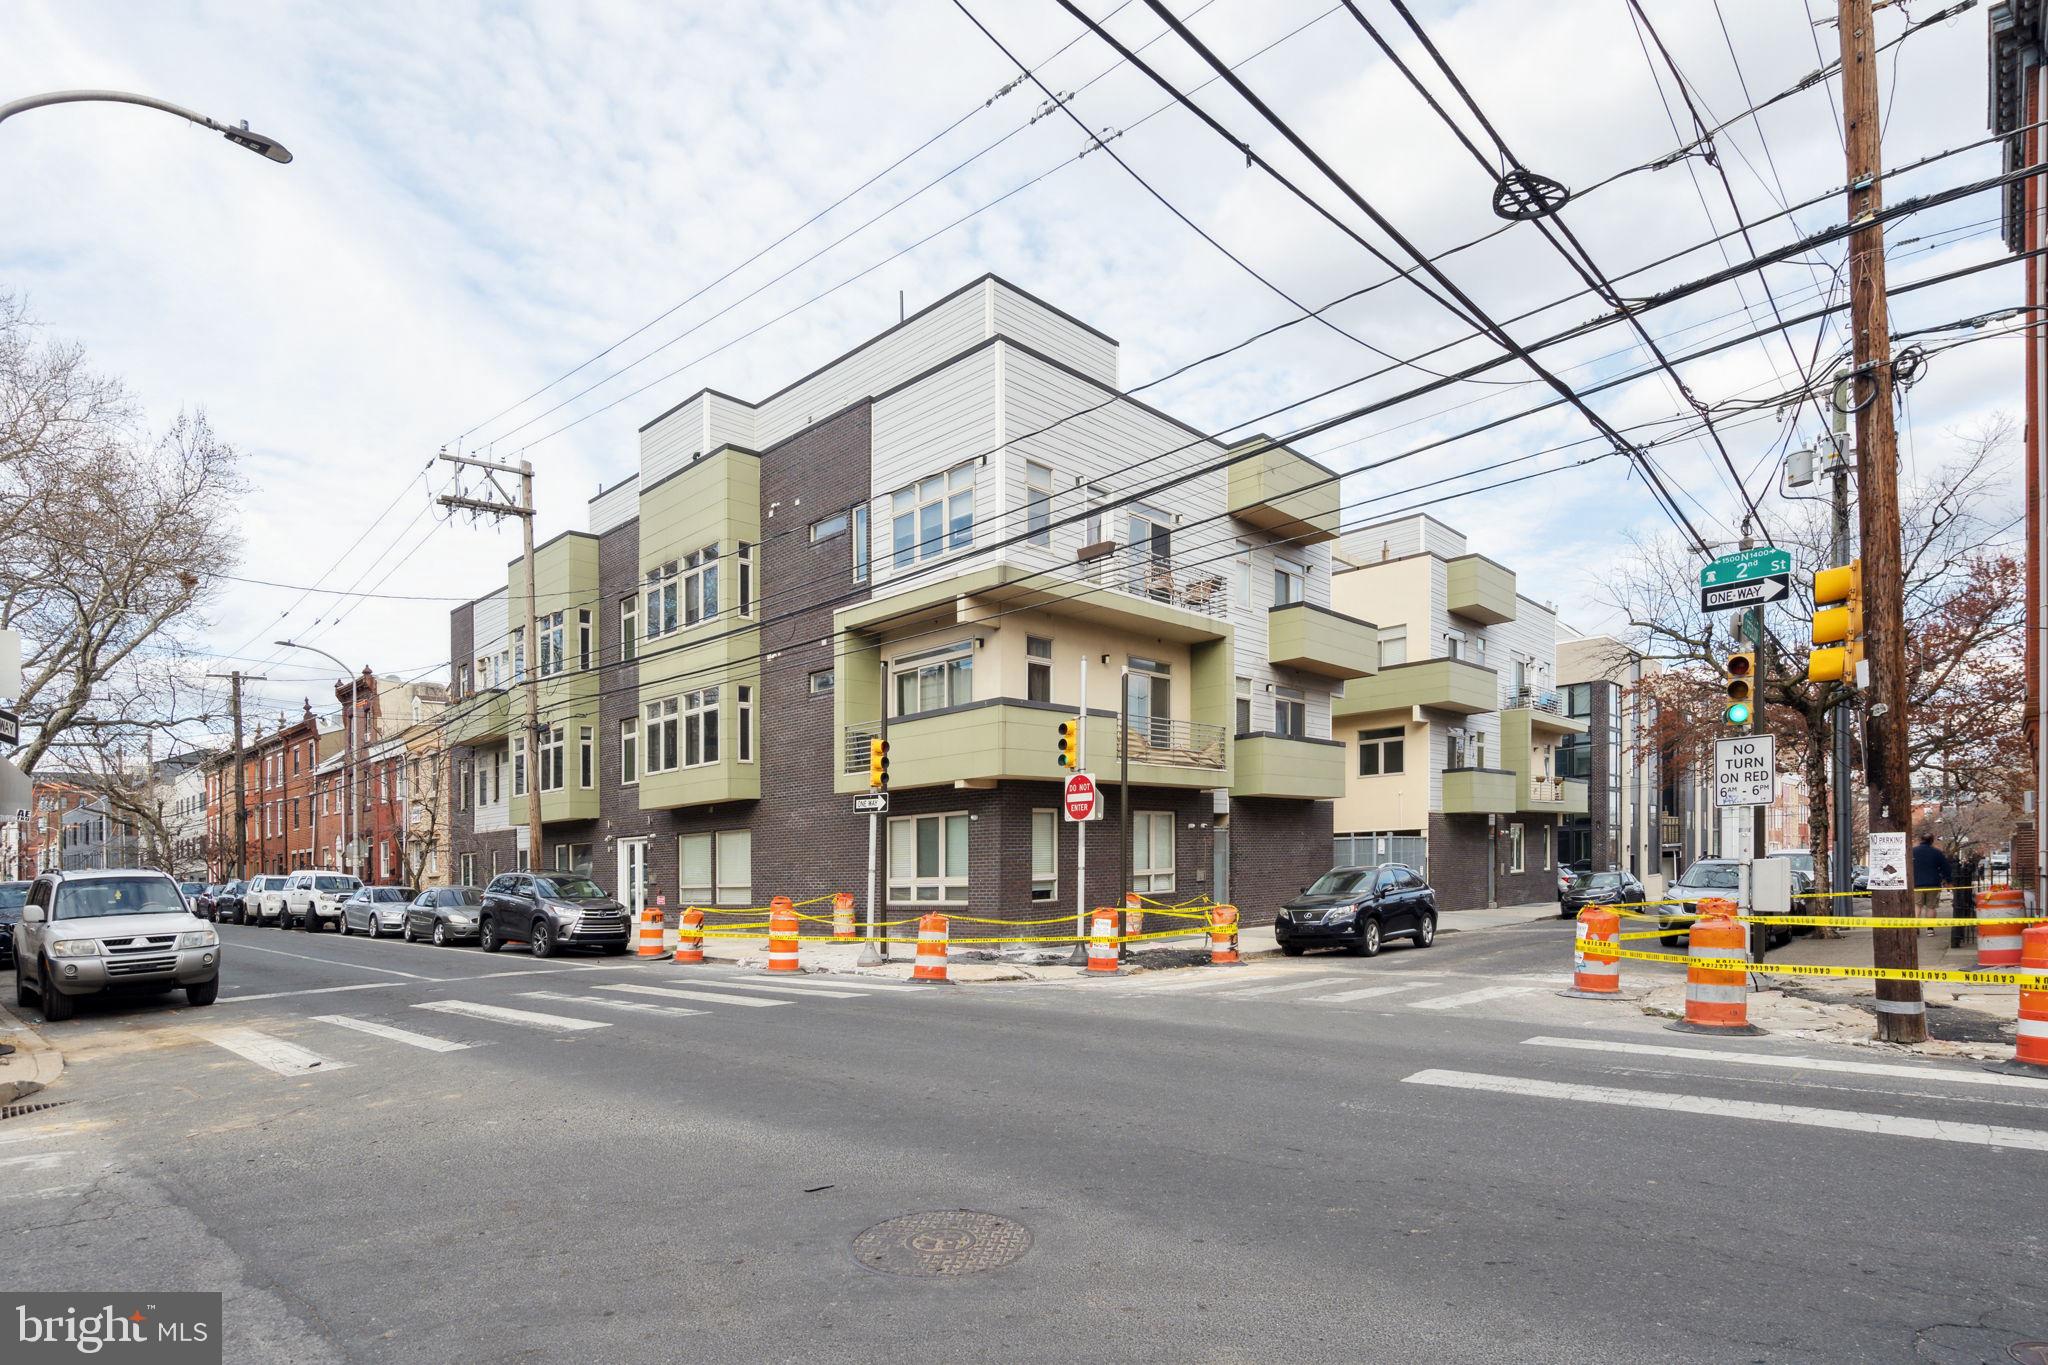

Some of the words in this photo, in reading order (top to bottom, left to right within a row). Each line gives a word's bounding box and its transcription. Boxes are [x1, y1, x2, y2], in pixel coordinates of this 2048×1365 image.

[1722, 556, 1740, 564] 1500
[1741, 553, 1749, 561] N
[1750, 550, 1769, 558] 1400
[1736, 560, 1758, 578] 2nd
[1771, 560, 1786, 571] St
[1710, 591, 1732, 604] ONE
[1738, 586, 1762, 599] WAY
[1733, 744, 1754, 755] NO
[1726, 757, 1763, 769] TURN
[1721, 773, 1738, 783] ON
[1744, 771, 1768, 782] RED
[1070, 784, 1076, 792] DO
[1079, 783, 1090, 791] NOT
[1902, 971, 1947, 980] CAUTION
[1964, 973, 2015, 983] CAUTION
